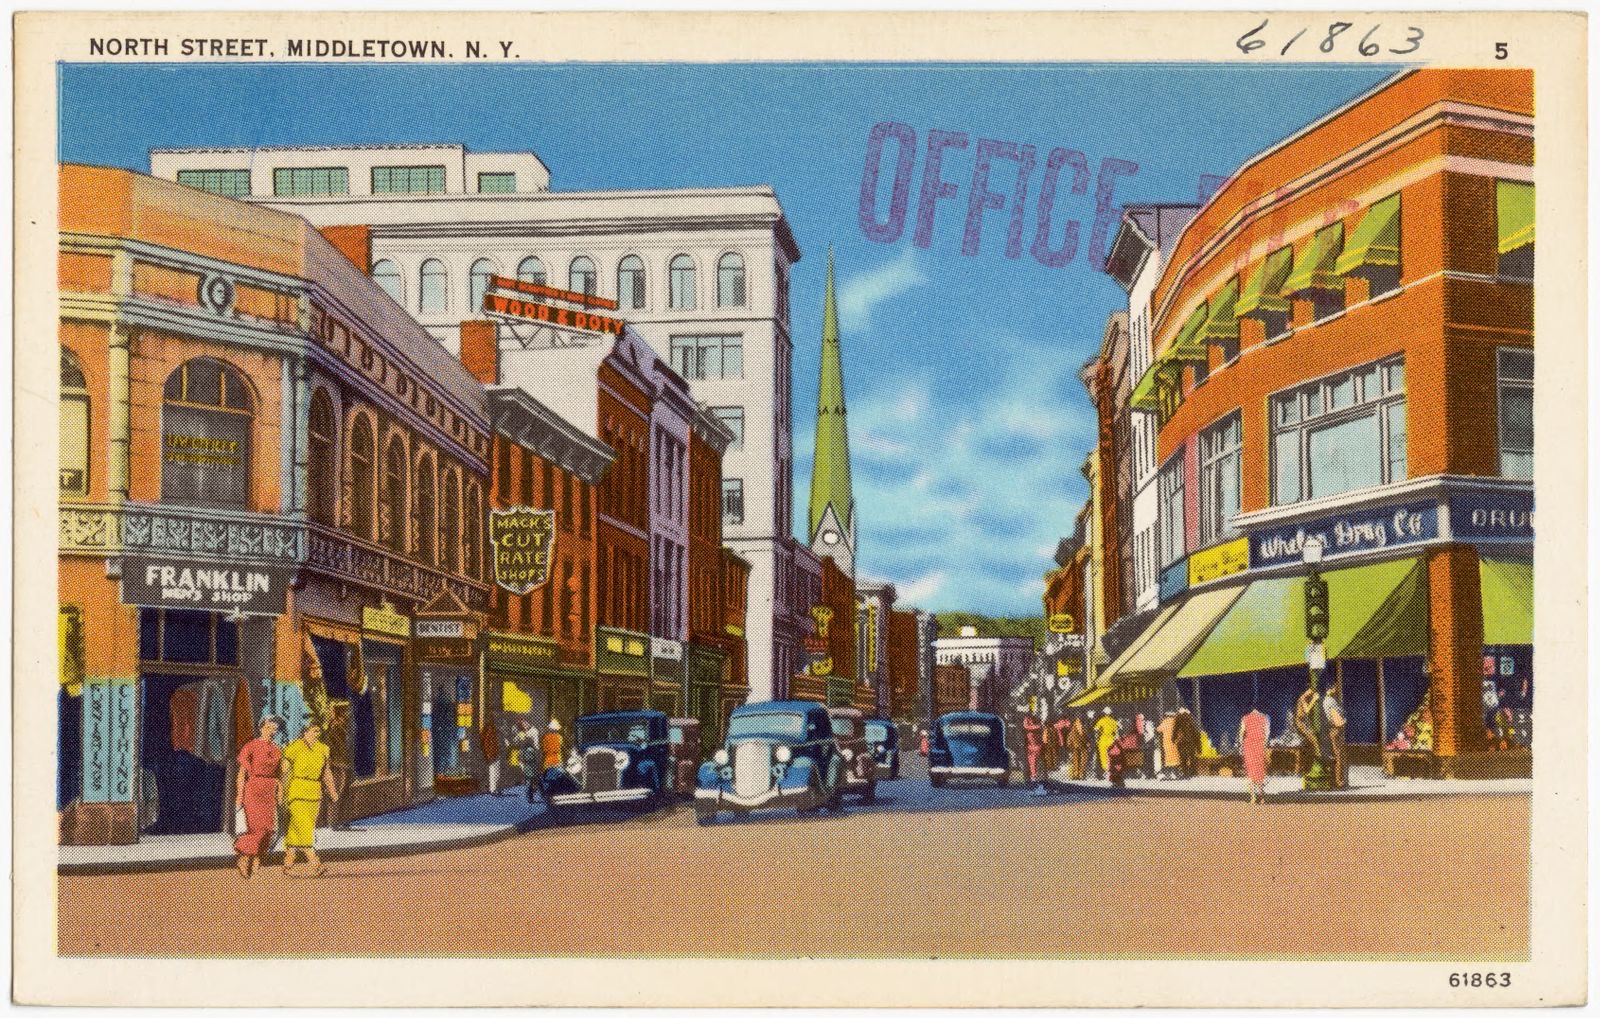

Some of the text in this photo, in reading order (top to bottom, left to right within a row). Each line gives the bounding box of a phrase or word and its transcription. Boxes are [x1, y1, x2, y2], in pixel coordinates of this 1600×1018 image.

[1236, 20, 1424, 56] 61863
[494, 296, 624, 336] WOOD & DOTY
[496, 516, 553, 531] MACK'S
[1471, 508, 1535, 528] DRU
[501, 532, 545, 549] CUT
[1334, 521, 1387, 547] Drug
[498, 550, 545, 565] RATE
[146, 565, 270, 593] FRANKLIN
[498, 566, 547, 582] SHOPS
[211, 591, 253, 603] SHOP
[417, 623, 461, 635] DENTIST
[117, 683, 130, 796] CLOTHING
